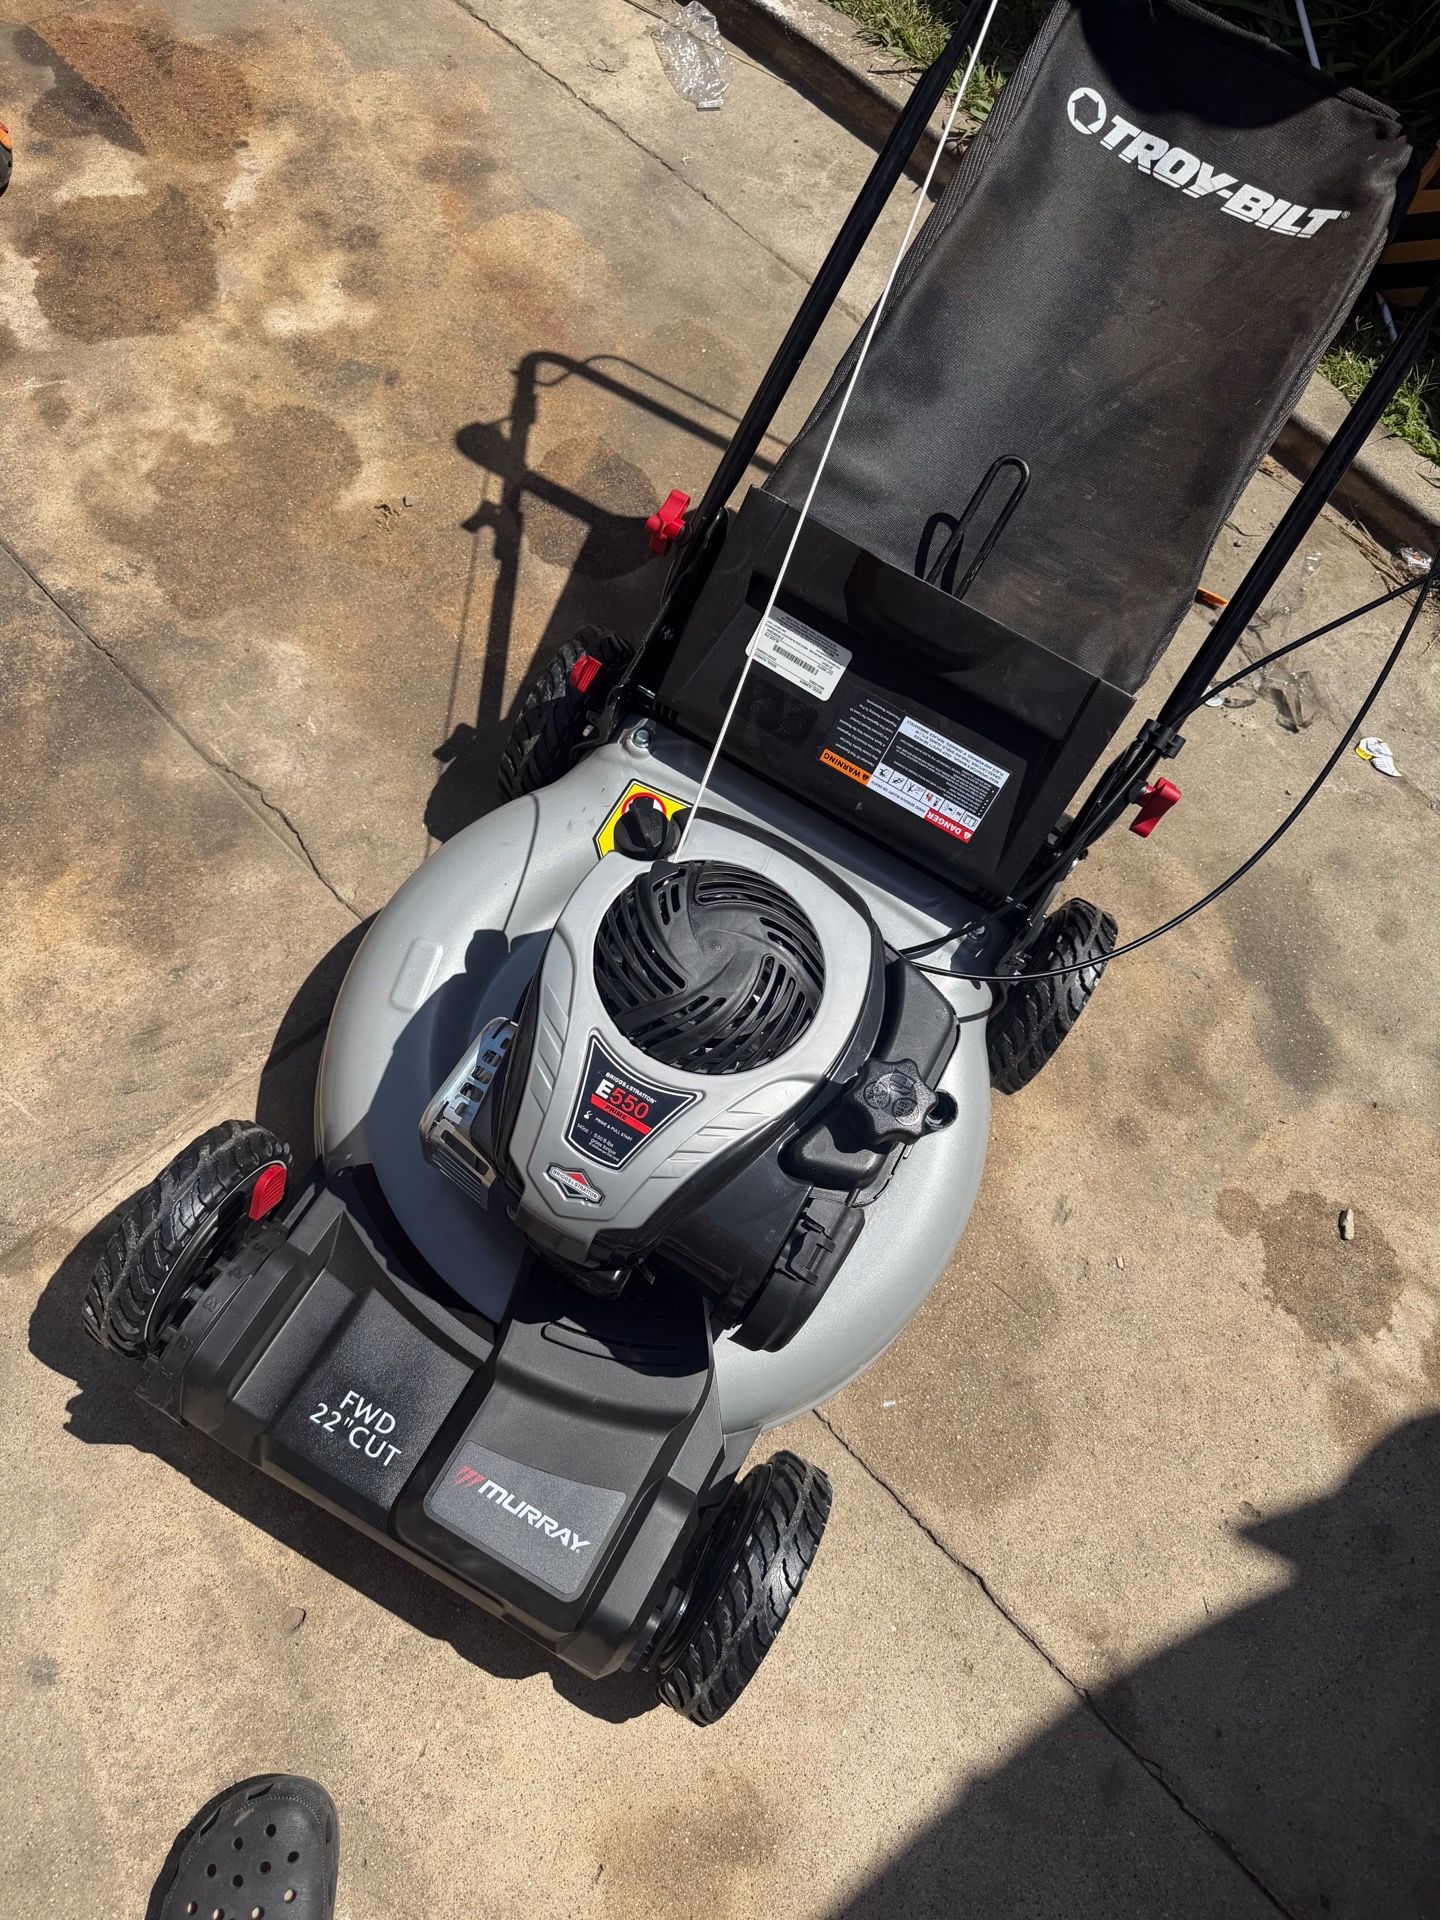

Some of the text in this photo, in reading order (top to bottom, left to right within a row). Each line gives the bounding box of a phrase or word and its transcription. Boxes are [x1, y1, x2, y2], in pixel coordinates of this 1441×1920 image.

[822, 751, 861, 777] WARNING
[925, 810, 962, 835] DANGER
[595, 1078, 650, 1118] E550
[604, 1104, 627, 1120] PRIME
[340, 1390, 396, 1434] FWD
